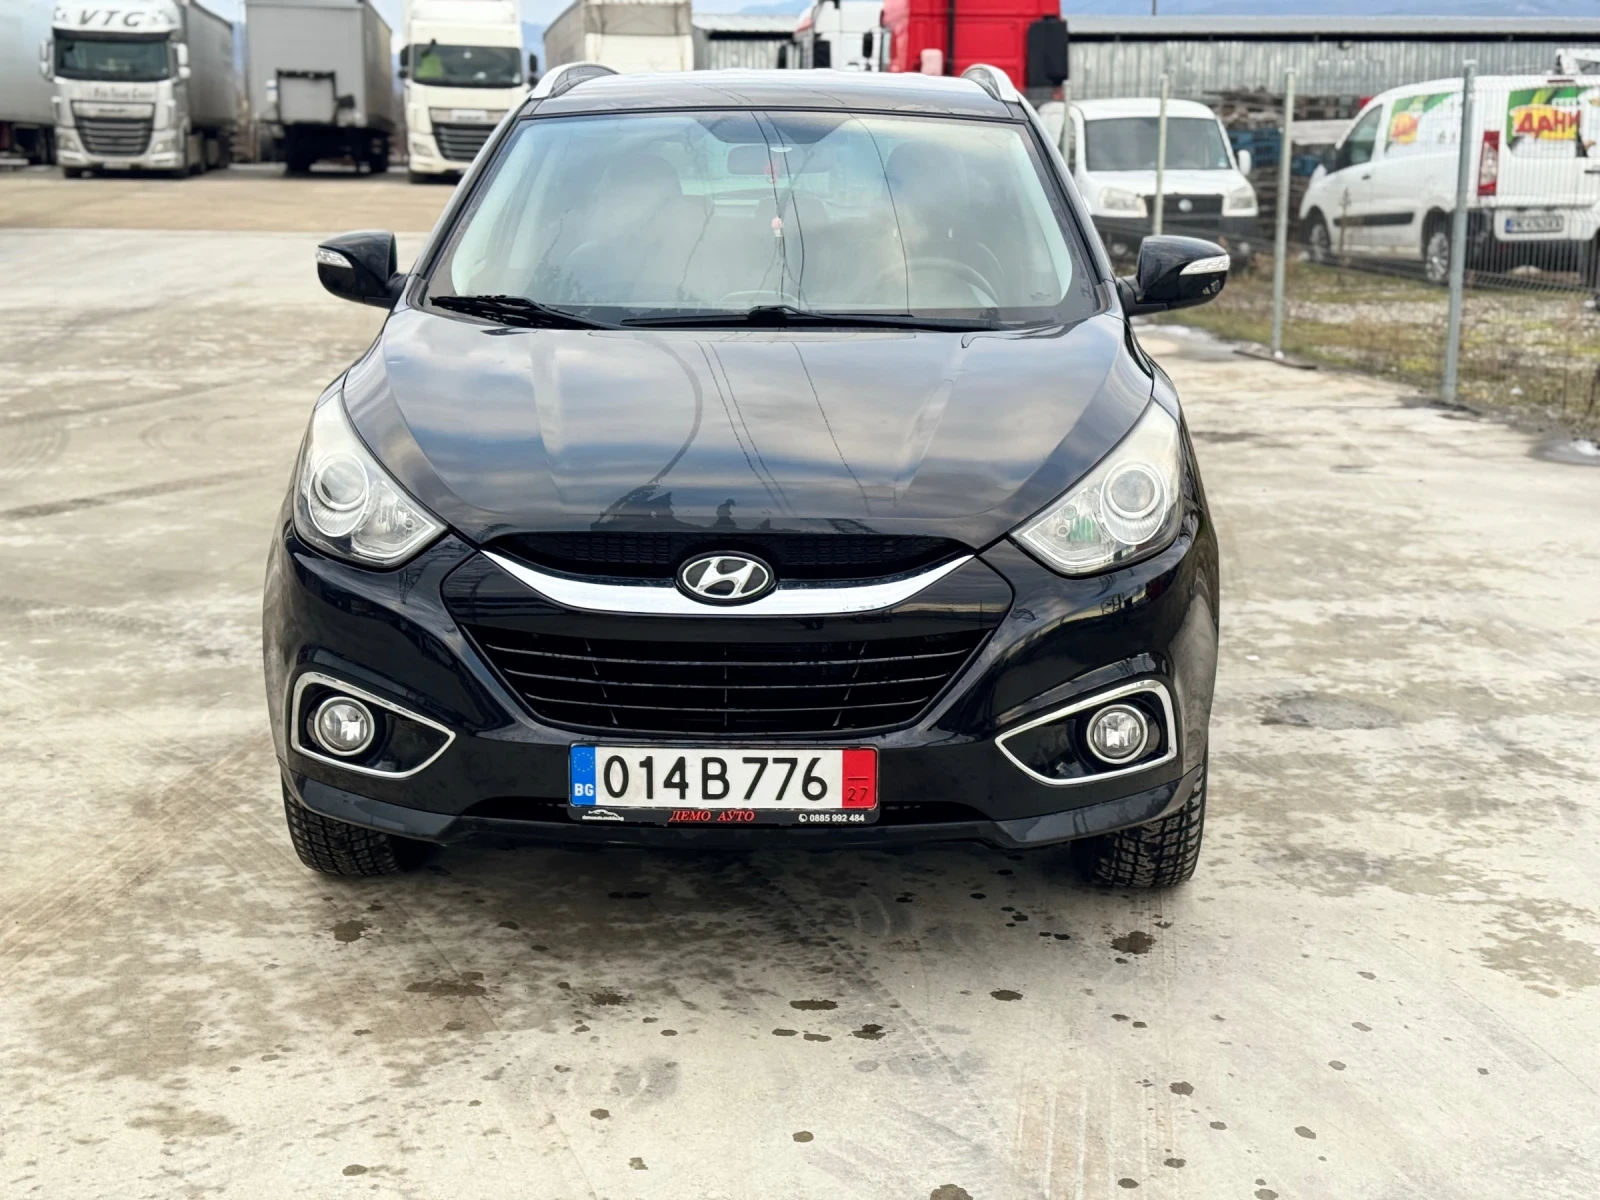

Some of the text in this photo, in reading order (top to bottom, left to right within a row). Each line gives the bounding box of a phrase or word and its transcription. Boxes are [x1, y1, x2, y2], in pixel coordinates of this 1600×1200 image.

[573, 783, 594, 797] BG
[847, 786, 868, 802] 27
[668, 809, 712, 823] ДЕМО
[809, 813, 866, 823] 0885 992 484
